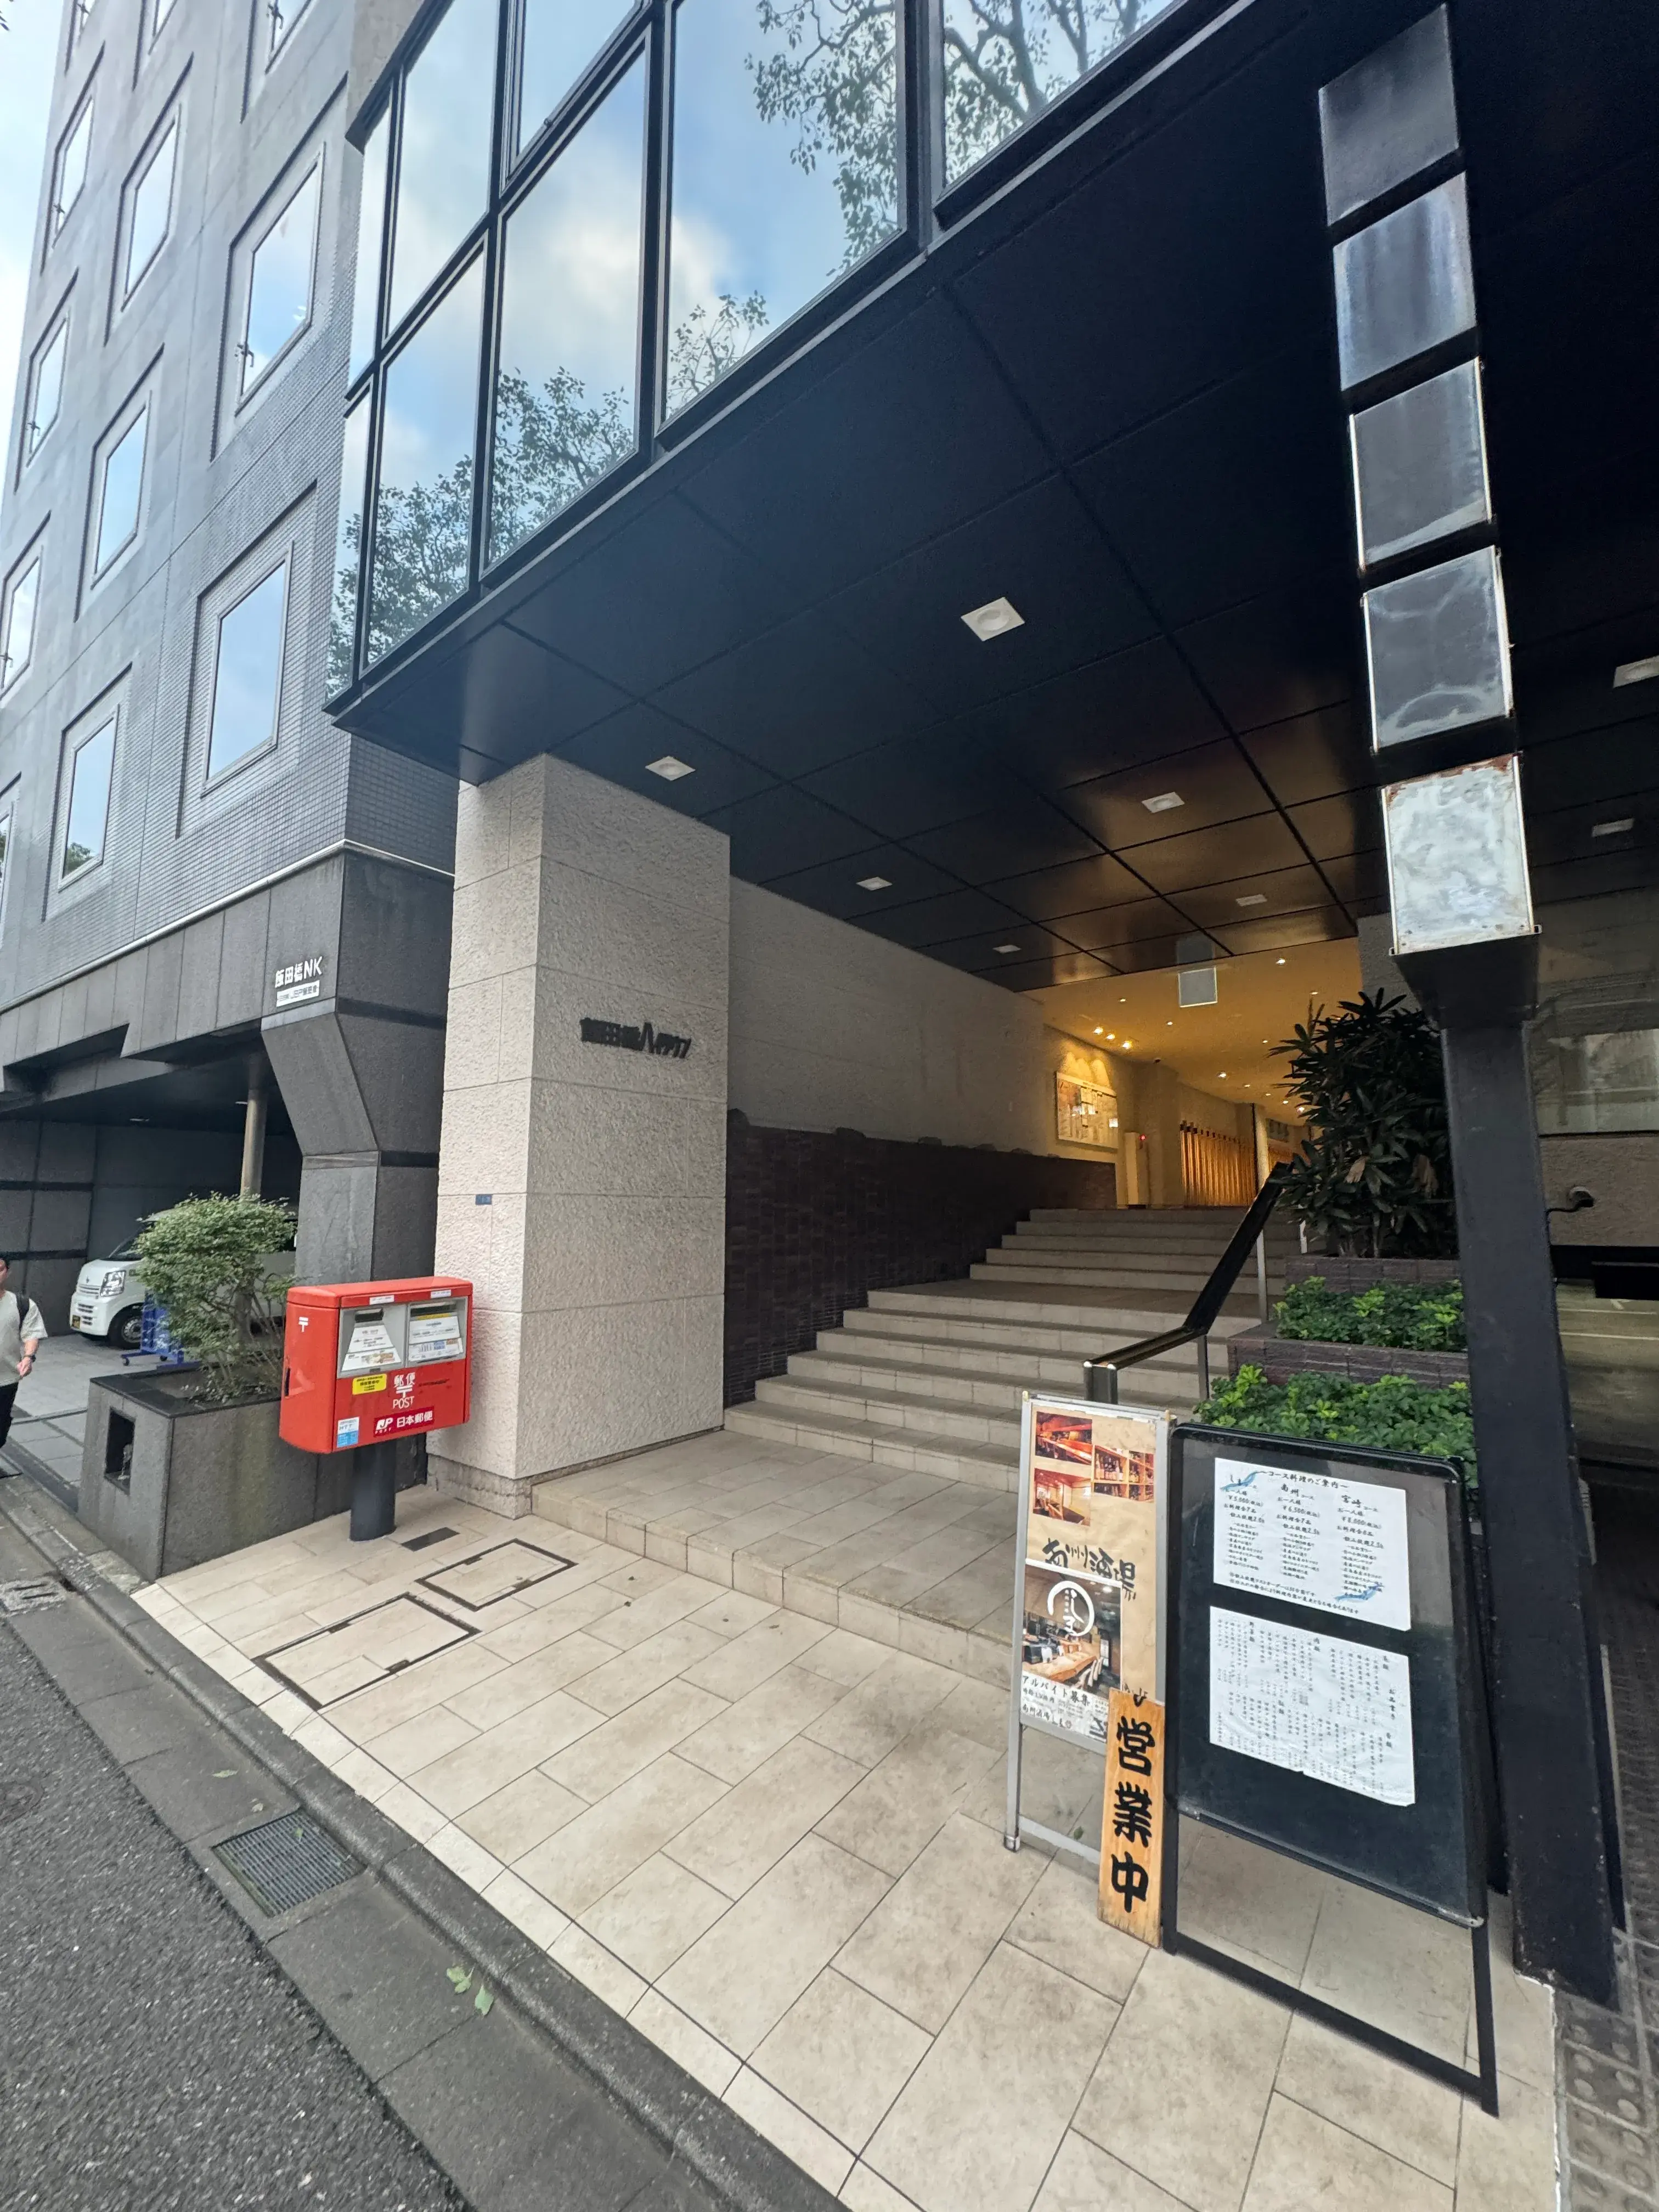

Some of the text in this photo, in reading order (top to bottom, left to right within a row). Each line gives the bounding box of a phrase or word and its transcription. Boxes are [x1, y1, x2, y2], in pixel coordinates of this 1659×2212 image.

[393, 1372, 415, 1388] 郵便
[393, 1396, 415, 1409] POST
[397, 1410, 433, 1428] 日本郵便
[1023, 1675, 1090, 1706] アルバイト募集
[1111, 1716, 1155, 1914] 営業中
